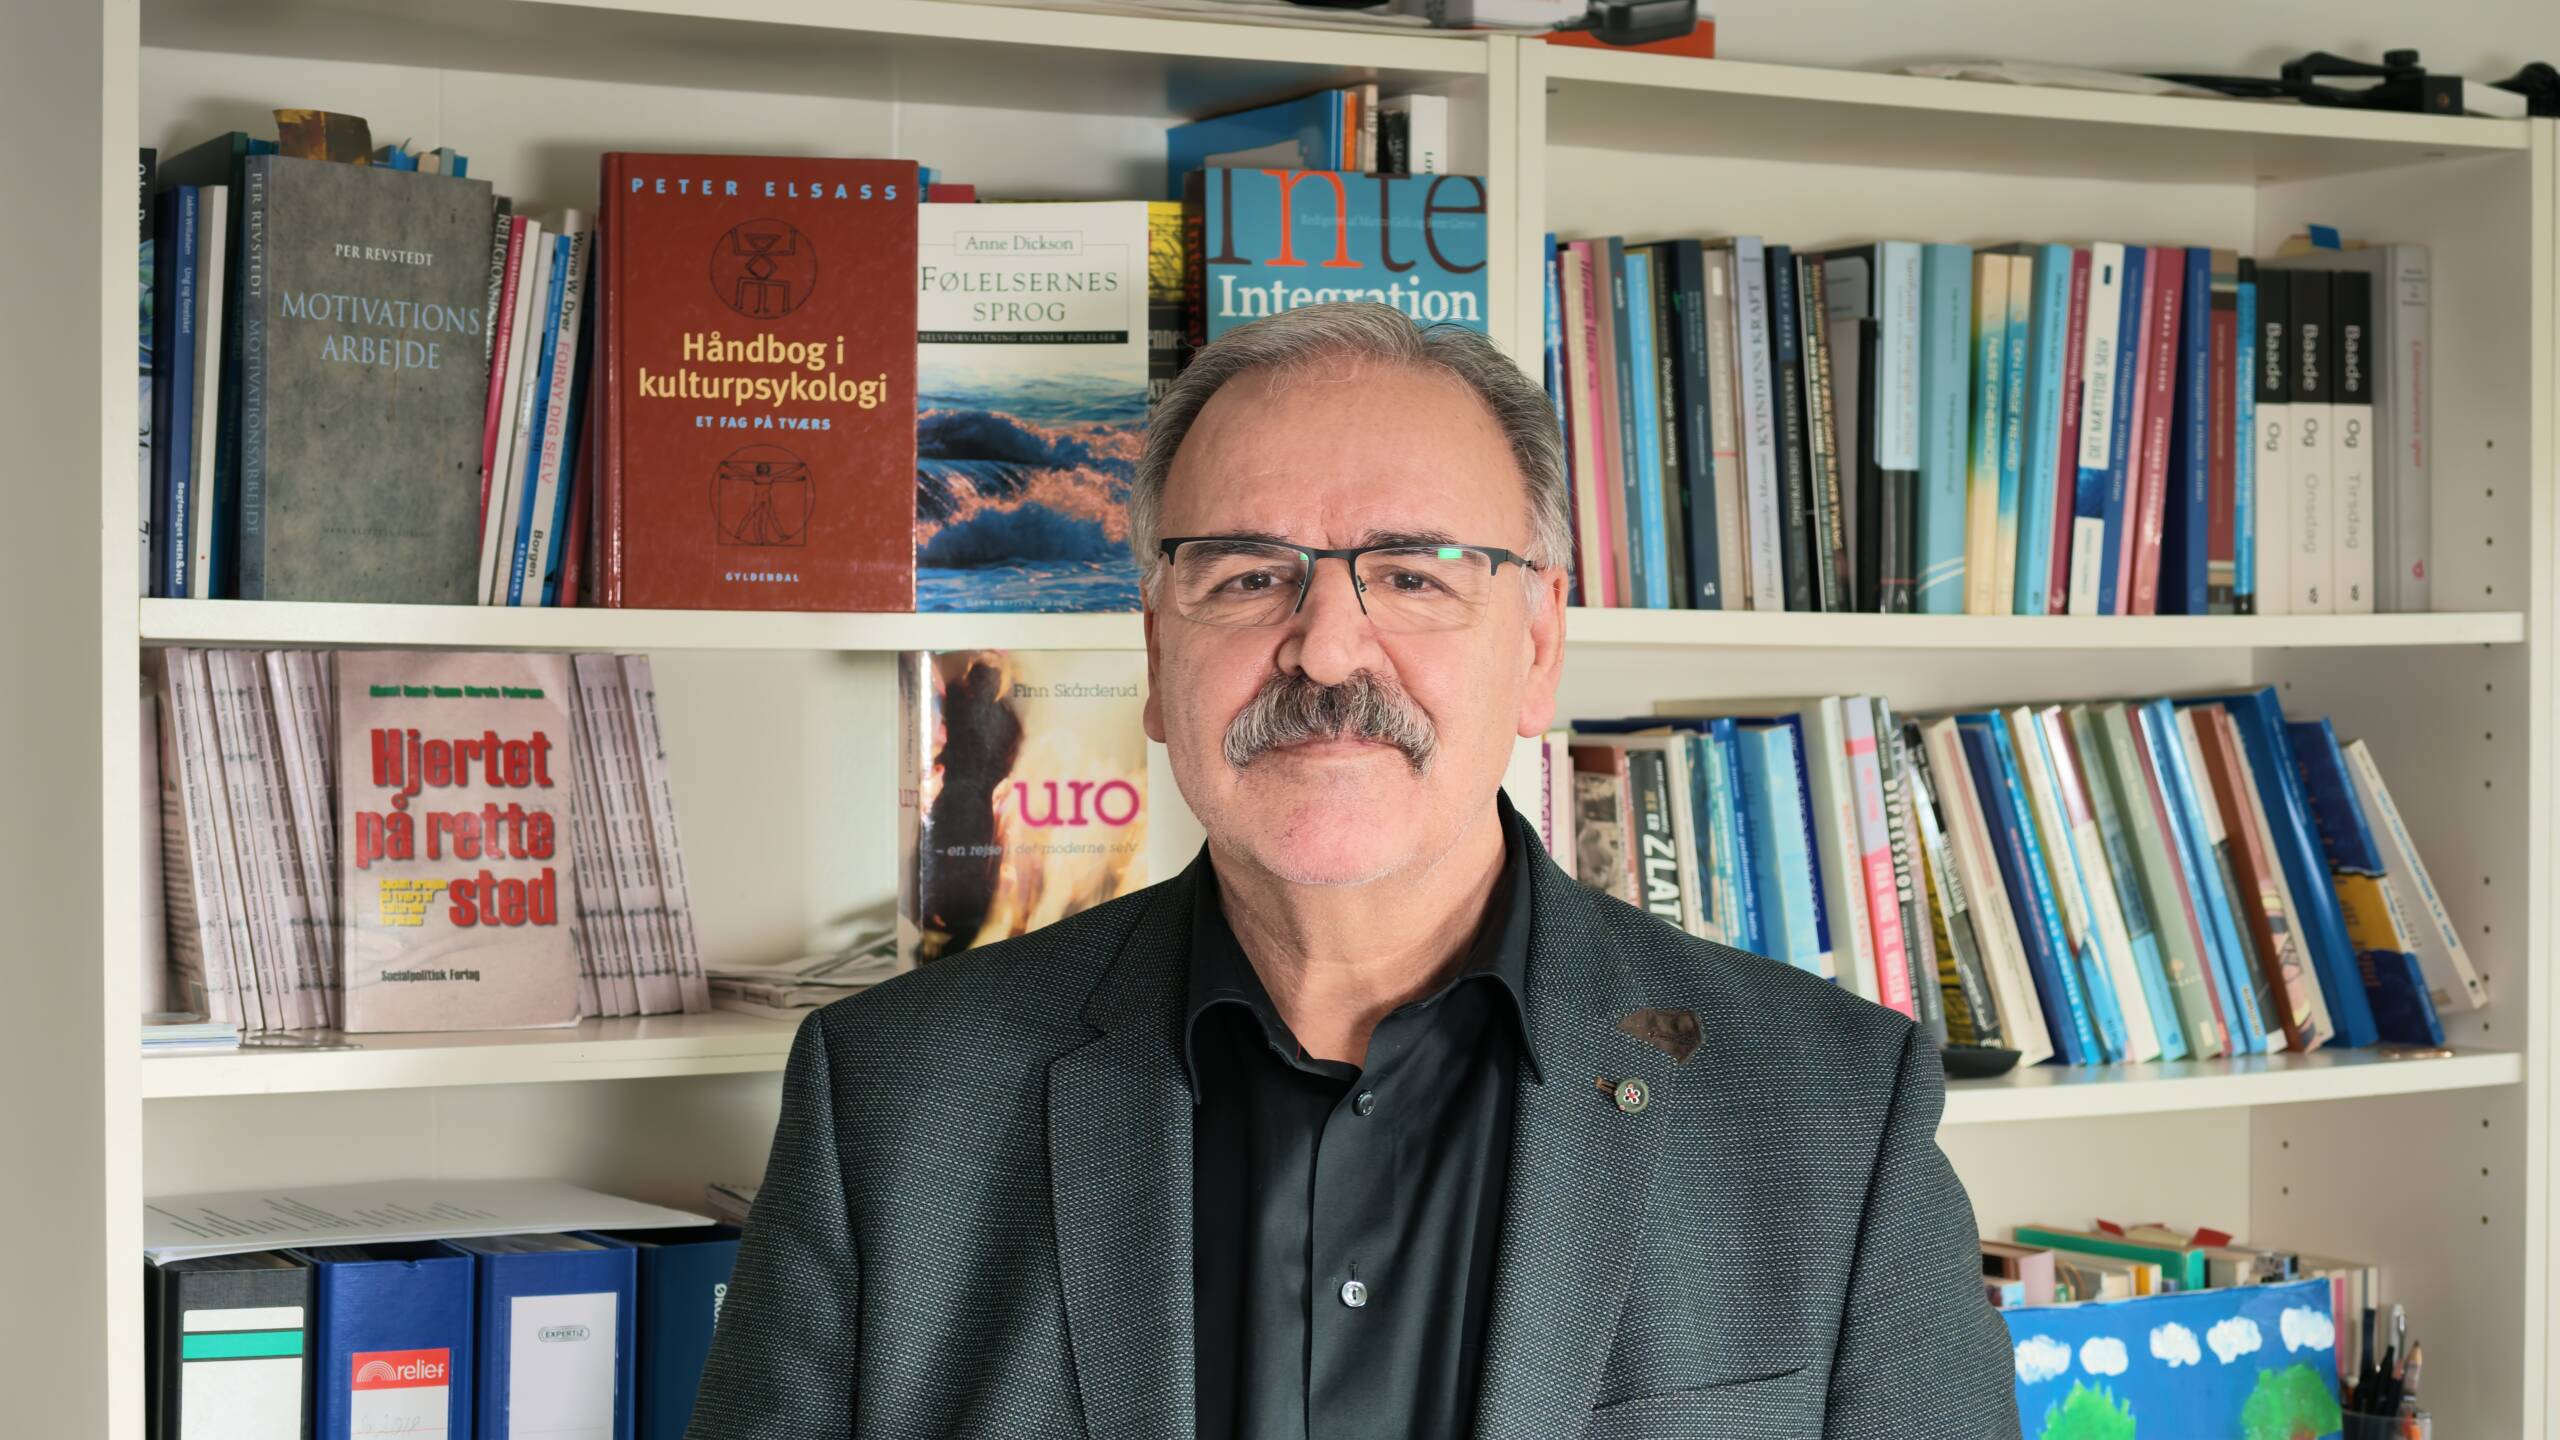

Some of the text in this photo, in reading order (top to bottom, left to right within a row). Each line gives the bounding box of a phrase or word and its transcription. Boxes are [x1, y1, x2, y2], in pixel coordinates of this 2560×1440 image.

[631, 177, 898, 201] PETER ELSASS
[335, 244, 434, 267] PER REVSTEDT
[568, 230, 585, 277] Wayne
[965, 233, 1074, 252] Anne Dickson
[182, 285, 192, 297] og
[183, 267, 193, 284] Ung
[565, 279, 578, 298] W.
[920, 266, 1118, 293] FØLELSERNES
[281, 291, 480, 335] MOTIVATIONS
[560, 300, 575, 332] Dyer
[972, 302, 1067, 323] SPROG
[1747, 283, 1763, 344] KRAFT
[244, 172, 264, 536] PER REVSTEDT MOTIVATIONSARBEJDE
[321, 335, 441, 373] ARBEJDE
[683, 332, 845, 371] Håndbog i
[1020, 330, 1064, 343] GENNEM
[551, 341, 569, 401] FORNY
[639, 367, 887, 409] kulturpsykologi
[2266, 323, 2282, 452] Baade Og
[1751, 349, 1769, 445] KVINDENS
[546, 405, 560, 436] DIG
[696, 412, 832, 431] ET FAG PÅ TVÆRS
[2303, 324, 2319, 554] Baade Og Onsdag
[2345, 325, 2361, 550] Baade Og Tirsdag
[539, 440, 555, 484] SELV
[174, 482, 186, 536] Bogforlaget
[173, 540, 184, 584] HER&NU
[525, 529, 543, 577] Borgen
[725, 571, 800, 583] GYLDENDAL
[175, 682, 185, 706] Ahmet
[1013, 683, 1138, 698] Finn Skårderud
[370, 729, 554, 797] Hjertet
[1015, 780, 1141, 828] uro
[355, 793, 556, 868] på rette
[1881, 779, 1914, 902] DEPRESSION
[947, 846, 966, 856] en
[969, 844, 1002, 859] rejse
[1041, 843, 1104, 855] moderne
[448, 868, 558, 928] sted
[1640, 830, 1684, 927] ZLAT
[381, 969, 480, 982] Socialpolitisk Forlag
[397, 1359, 445, 1380] relief
